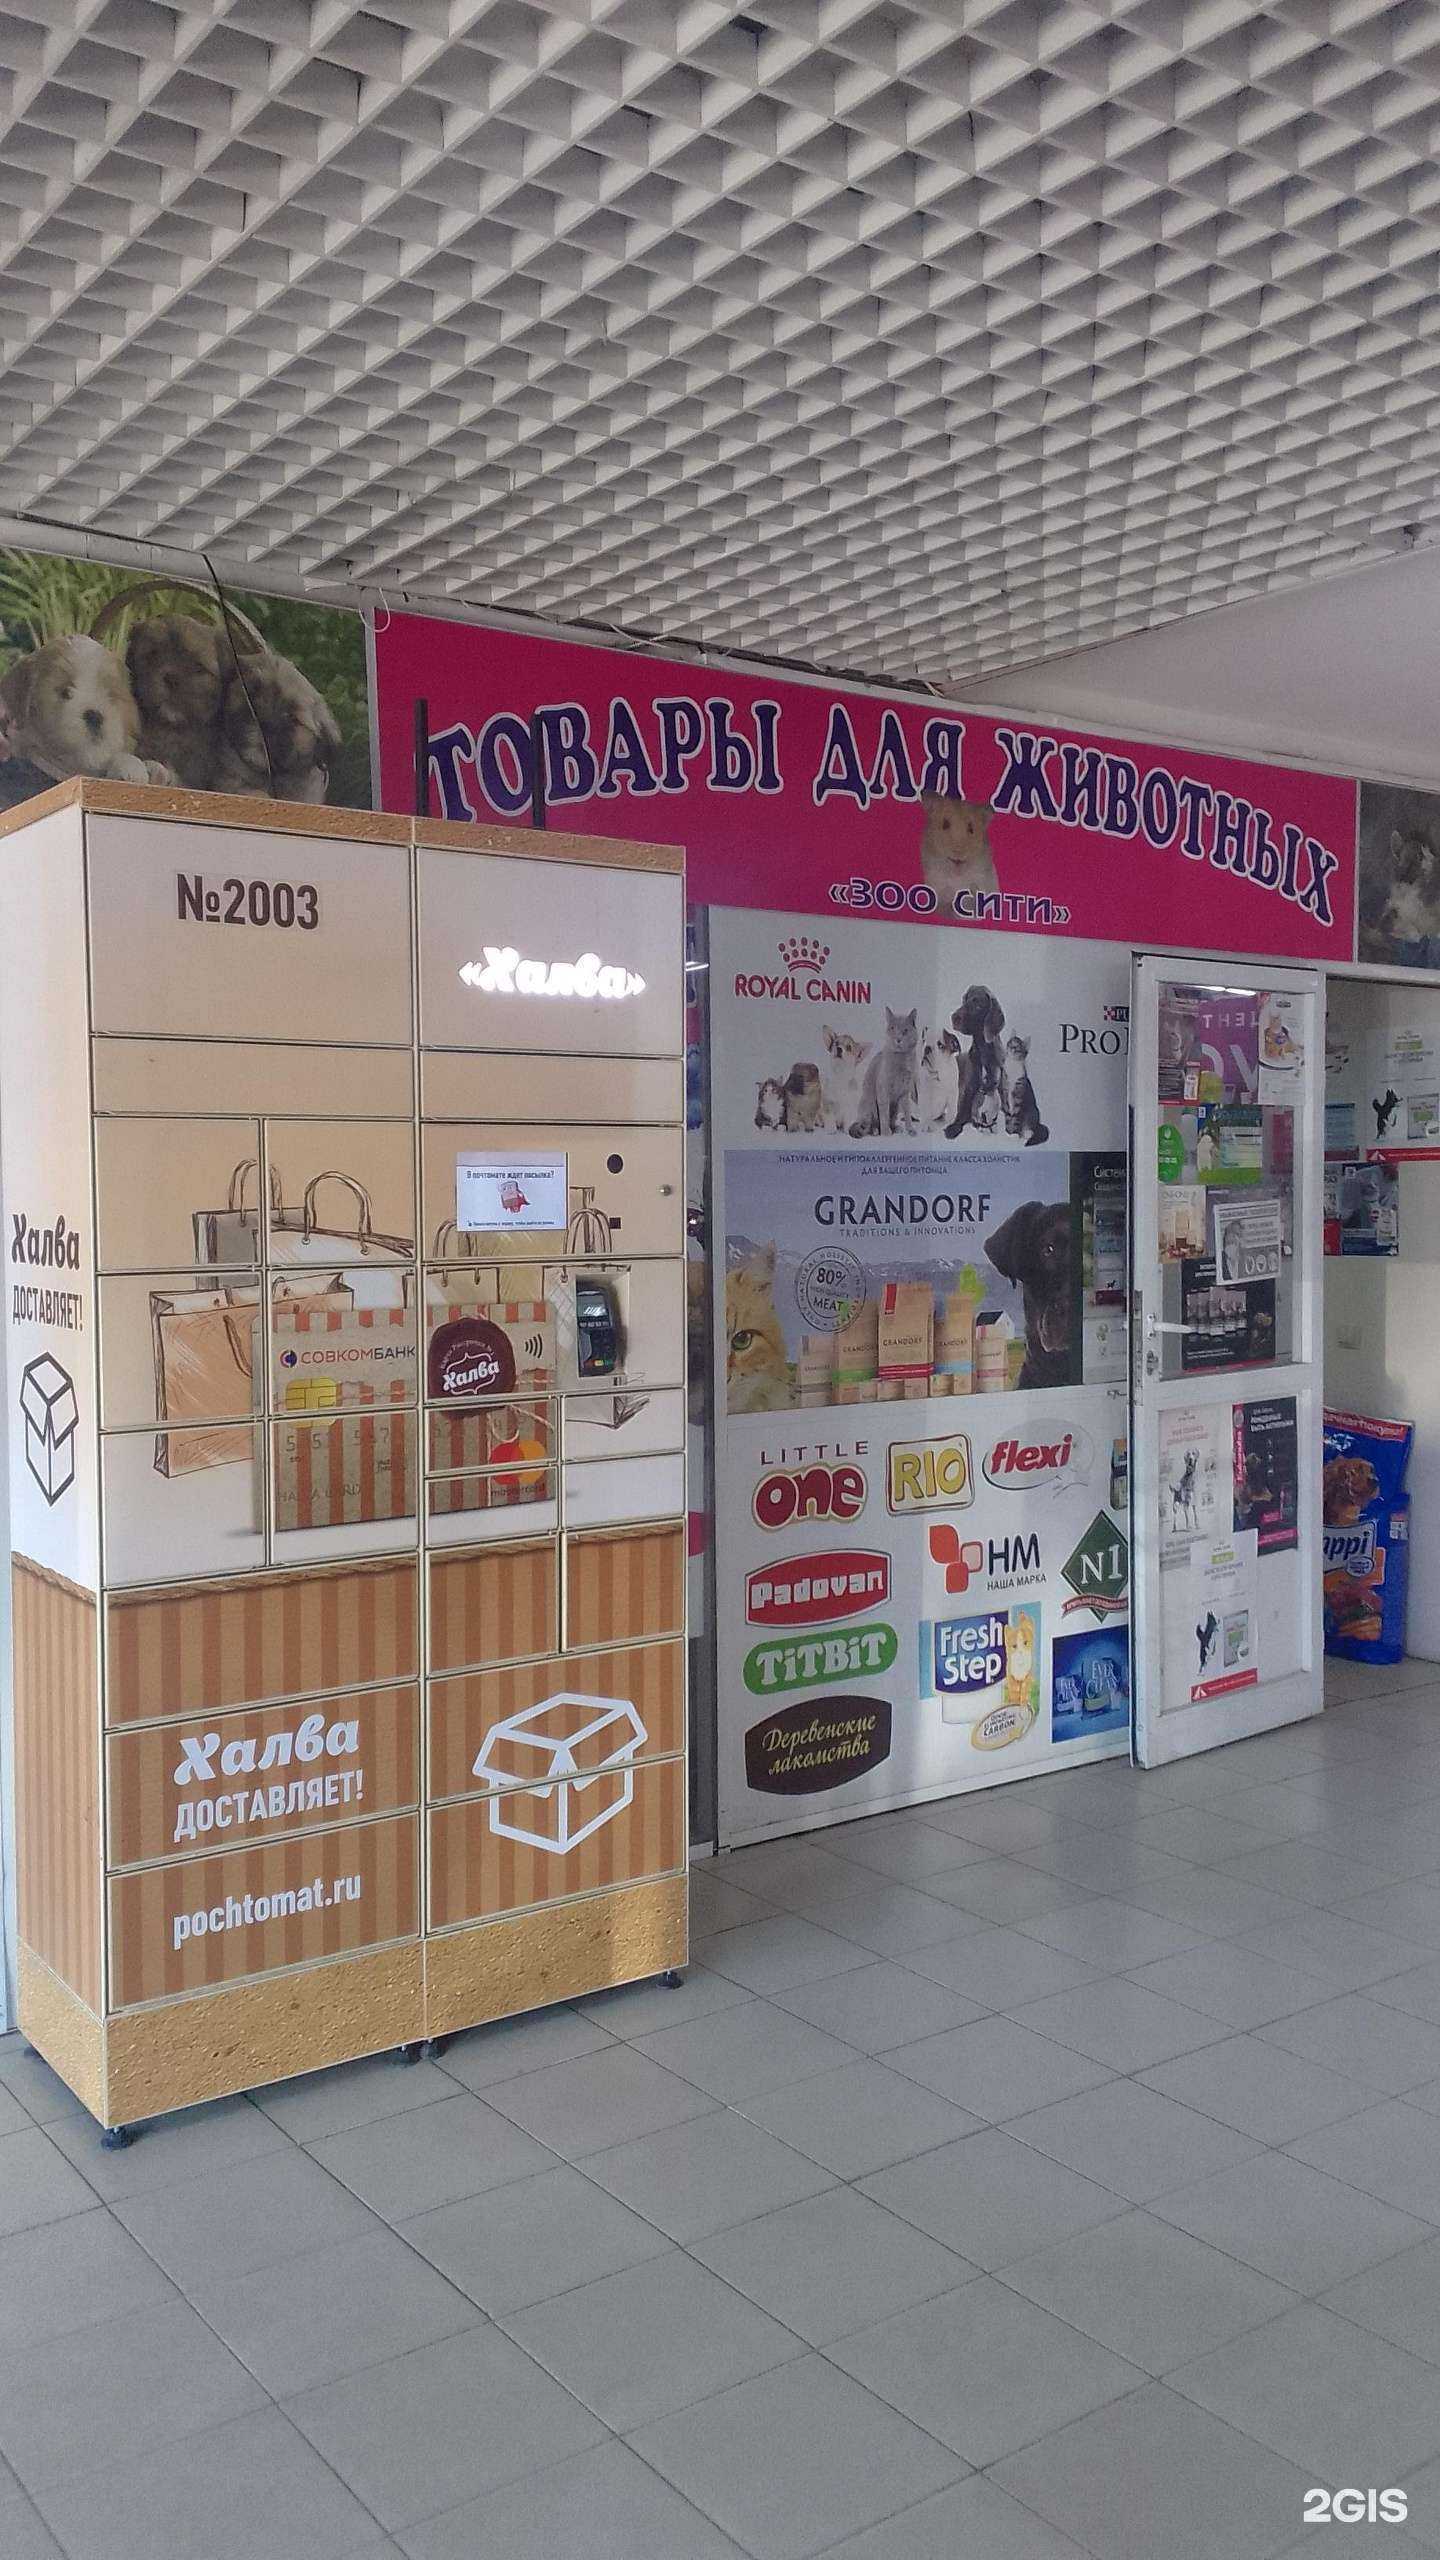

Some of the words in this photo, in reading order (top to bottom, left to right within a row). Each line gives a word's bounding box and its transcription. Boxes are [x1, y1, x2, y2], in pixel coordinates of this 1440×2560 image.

[414, 697, 784, 824] ТОВАРЫ
[812, 703, 967, 811] ДЛЯ
[990, 727, 1338, 927] ЖИВОТНЫХ
[176, 873, 320, 931] №2003
[734, 974, 801, 1001] ROYAL
[806, 978, 871, 1004] CANIN
[814, 1193, 992, 1226] GRANDORF
[11, 1213, 80, 1271] Халва
[840, 1228, 900, 1238] TRADITIONS
[914, 1226, 976, 1237] INNOVATIONS
[817, 1267, 847, 1287] 80%
[12, 1284, 83, 1332] ДОСТАВЛЯЕТ!
[813, 1297, 844, 1312] MEAT
[301, 1344, 416, 1365] СОВКОМБАНК
[442, 1360, 500, 1392] Халва
[761, 1441, 869, 1465] LITTLE
[990, 1433, 1072, 1475] flexi
[893, 1448, 966, 1502] RIO
[754, 1464, 867, 1530] one
[987, 1578, 1015, 1592] НАША
[1016, 1573, 1047, 1588] МАРКА
[1080, 1544, 1123, 1585] N1
[751, 1568, 884, 1609] Padovan
[940, 1616, 1004, 1656] Fresh
[944, 1652, 1002, 1686] Step
[763, 1712, 878, 1754] Деревенские
[983, 1719, 1015, 1737] CARBON
[173, 1713, 360, 1785] Халва
[768, 1738, 870, 1777] лакомства
[173, 1769, 365, 1844] ДОСТАВЛЯЕТ!
[173, 1873, 361, 1950] pochtomat.ru
